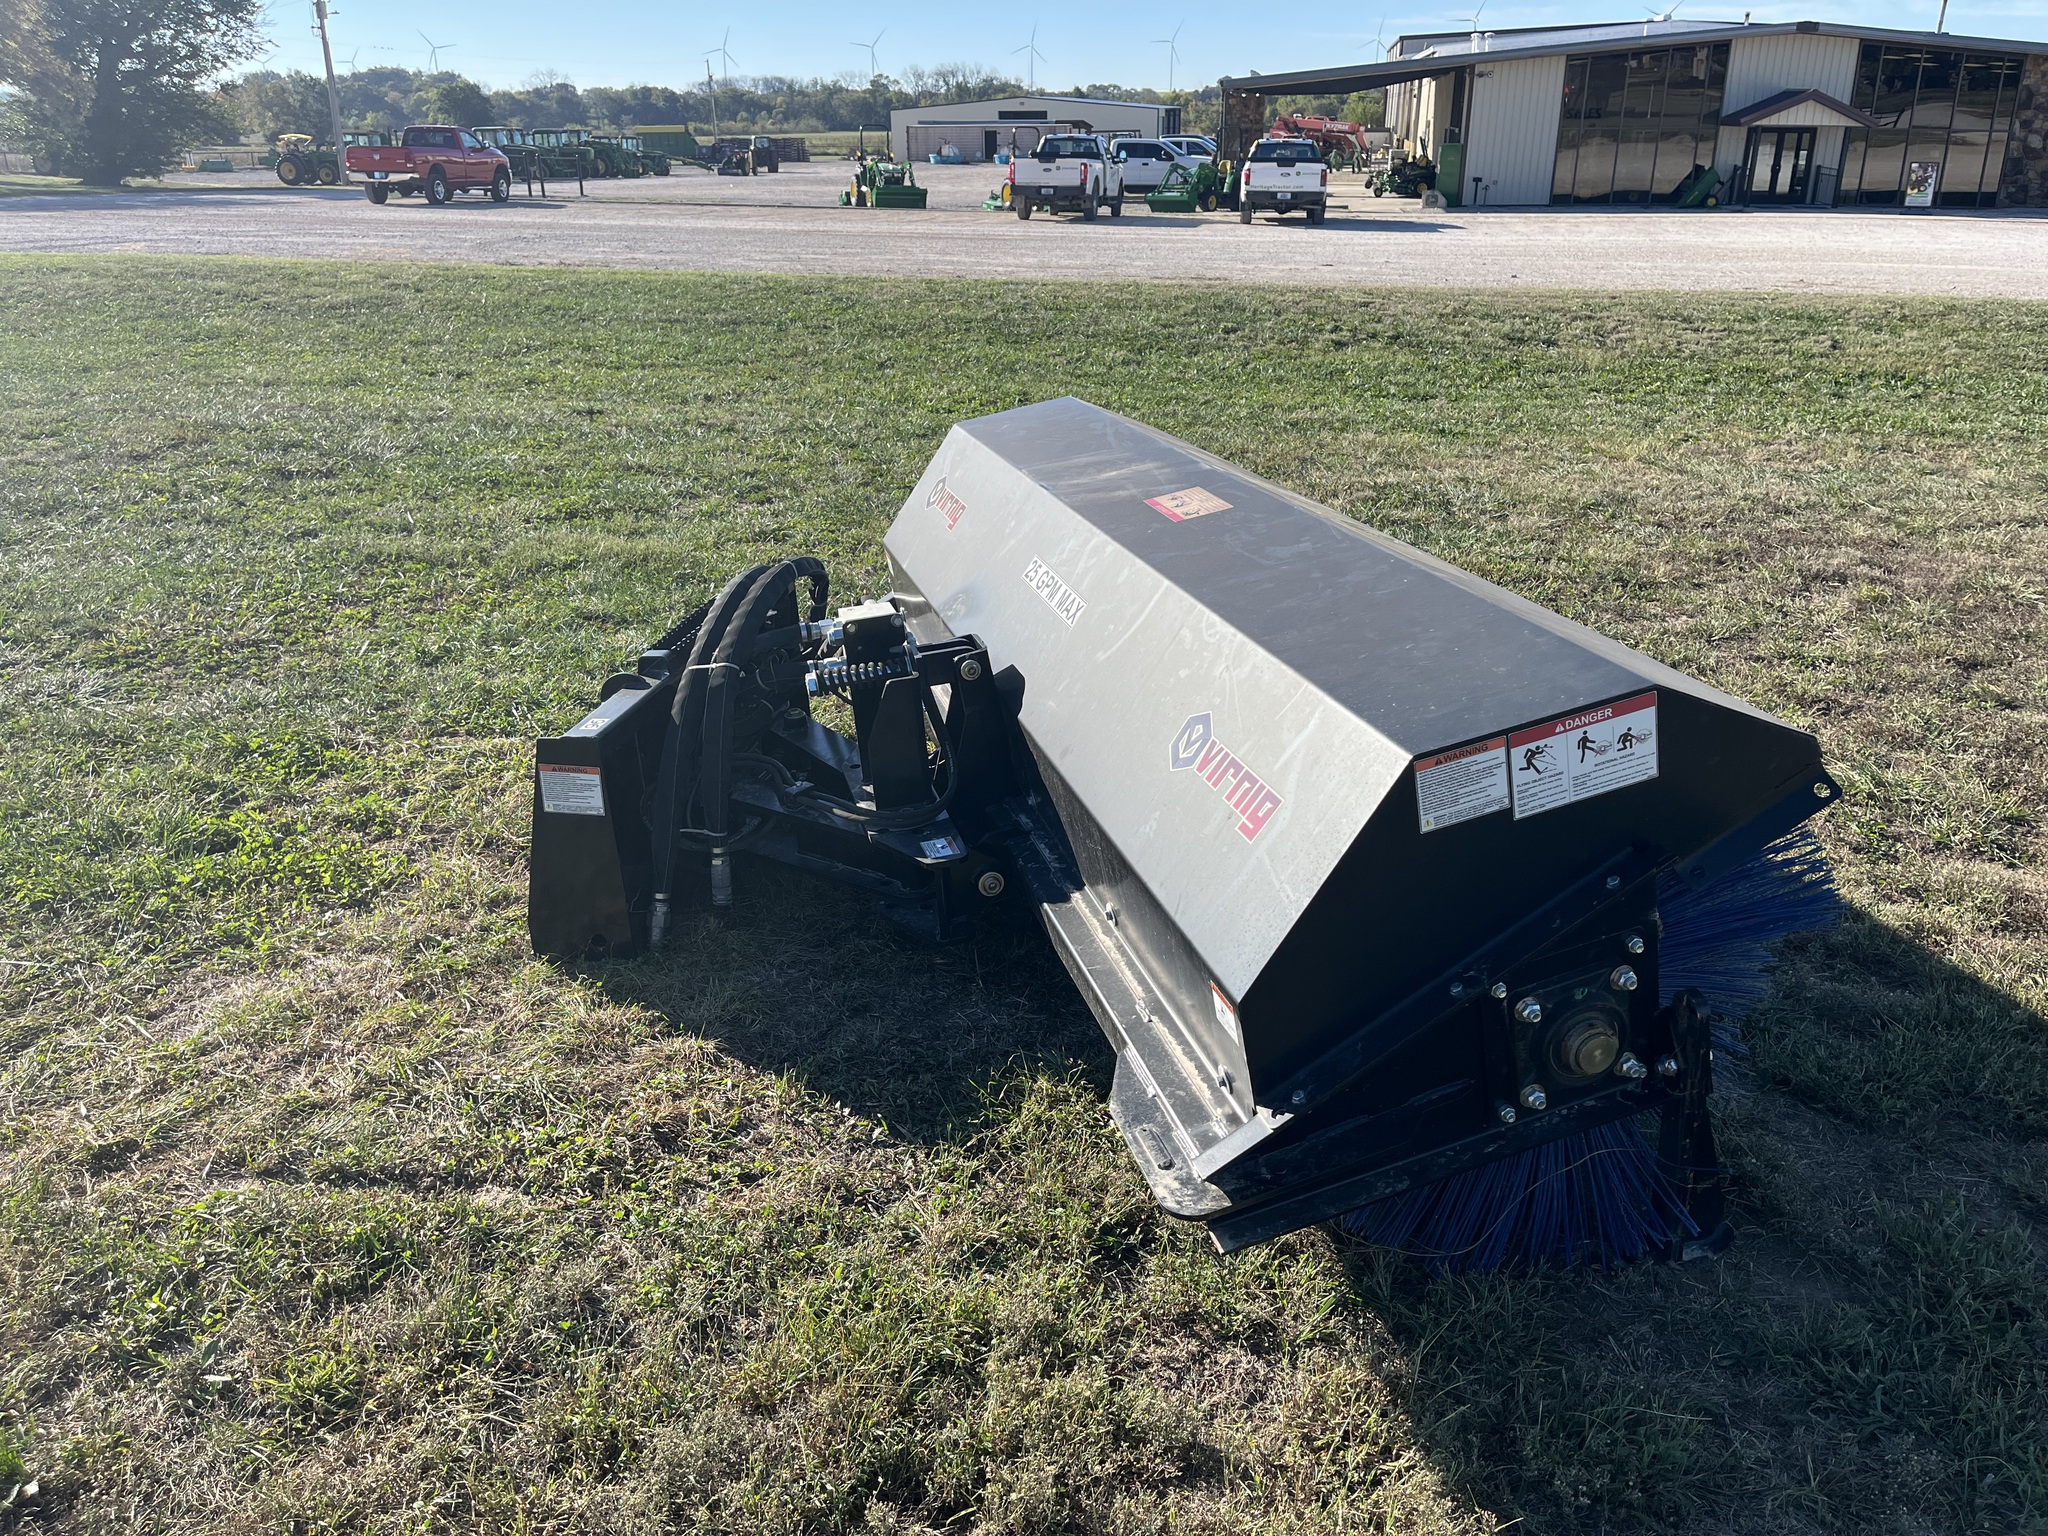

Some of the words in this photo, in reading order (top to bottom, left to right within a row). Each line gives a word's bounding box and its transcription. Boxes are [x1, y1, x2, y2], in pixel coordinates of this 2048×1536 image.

[1566, 107, 1602, 119] SALES
[1024, 559, 1042, 583] 25
[1035, 570, 1063, 604] GPM
[1054, 588, 1085, 625] MAX
[1565, 708, 1613, 729] DANGER
[1443, 743, 1489, 763] WARNING
[1594, 757, 1619, 768] ROTATIONAL
[1619, 752, 1636, 761] HAZARD
[557, 766, 588, 774] WARNING
[1516, 781, 1531, 789] FLYING
[1531, 777, 1547, 785] OBJECT
[1547, 771, 1564, 779] HAZARD
[1194, 737, 1284, 843] virnig
